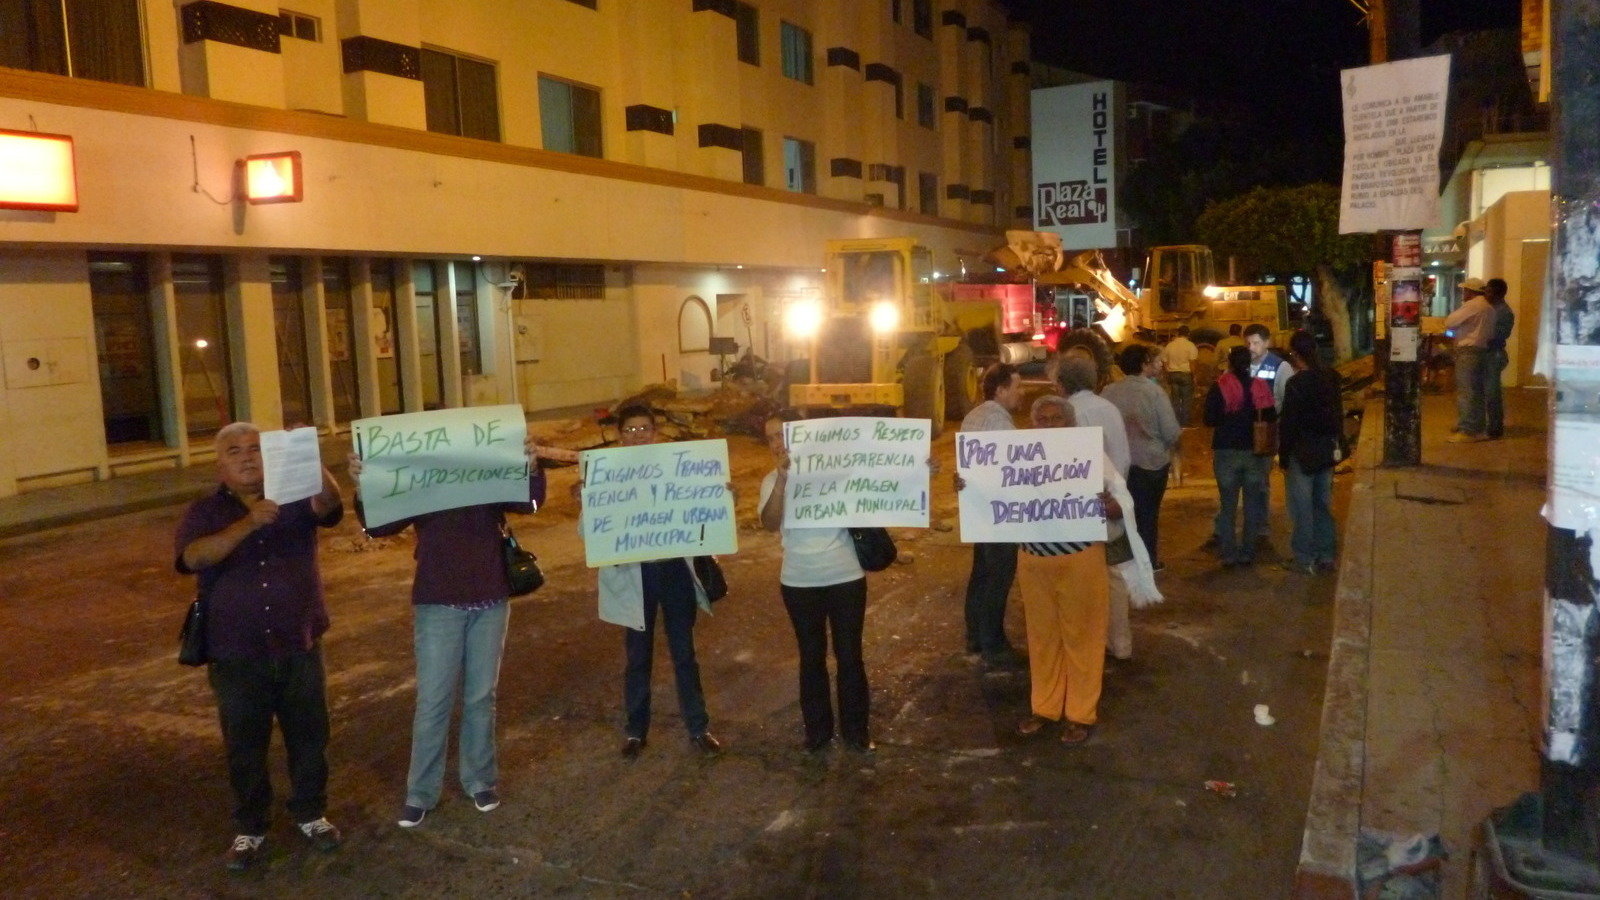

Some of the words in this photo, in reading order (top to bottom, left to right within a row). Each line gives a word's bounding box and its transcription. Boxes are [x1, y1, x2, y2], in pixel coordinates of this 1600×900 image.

[1093, 93, 1107, 184] HOTEL
[1039, 183, 1096, 204] Plaza
[1039, 199, 1086, 226] Real
[472, 419, 505, 446] DE
[872, 421, 925, 441] RESPETO
[673, 450, 725, 477] TRANSPA
[794, 454, 801, 474] Y
[807, 452, 915, 473] TRANSPARENCIA
[1007, 441, 1046, 463] UNA
[1001, 458, 1091, 487] PLANEACIÓN
[587, 487, 638, 507] RENCIA
[651, 484, 657, 506] Y
[665, 482, 724, 501] RESPETO
[793, 482, 812, 499] DE
[819, 480, 837, 496] LA
[844, 478, 899, 493] IMAGEN
[593, 516, 613, 533] DE
[624, 509, 674, 529] IMAGEN
[683, 506, 728, 524] URBANA
[795, 501, 847, 520] URBANA
